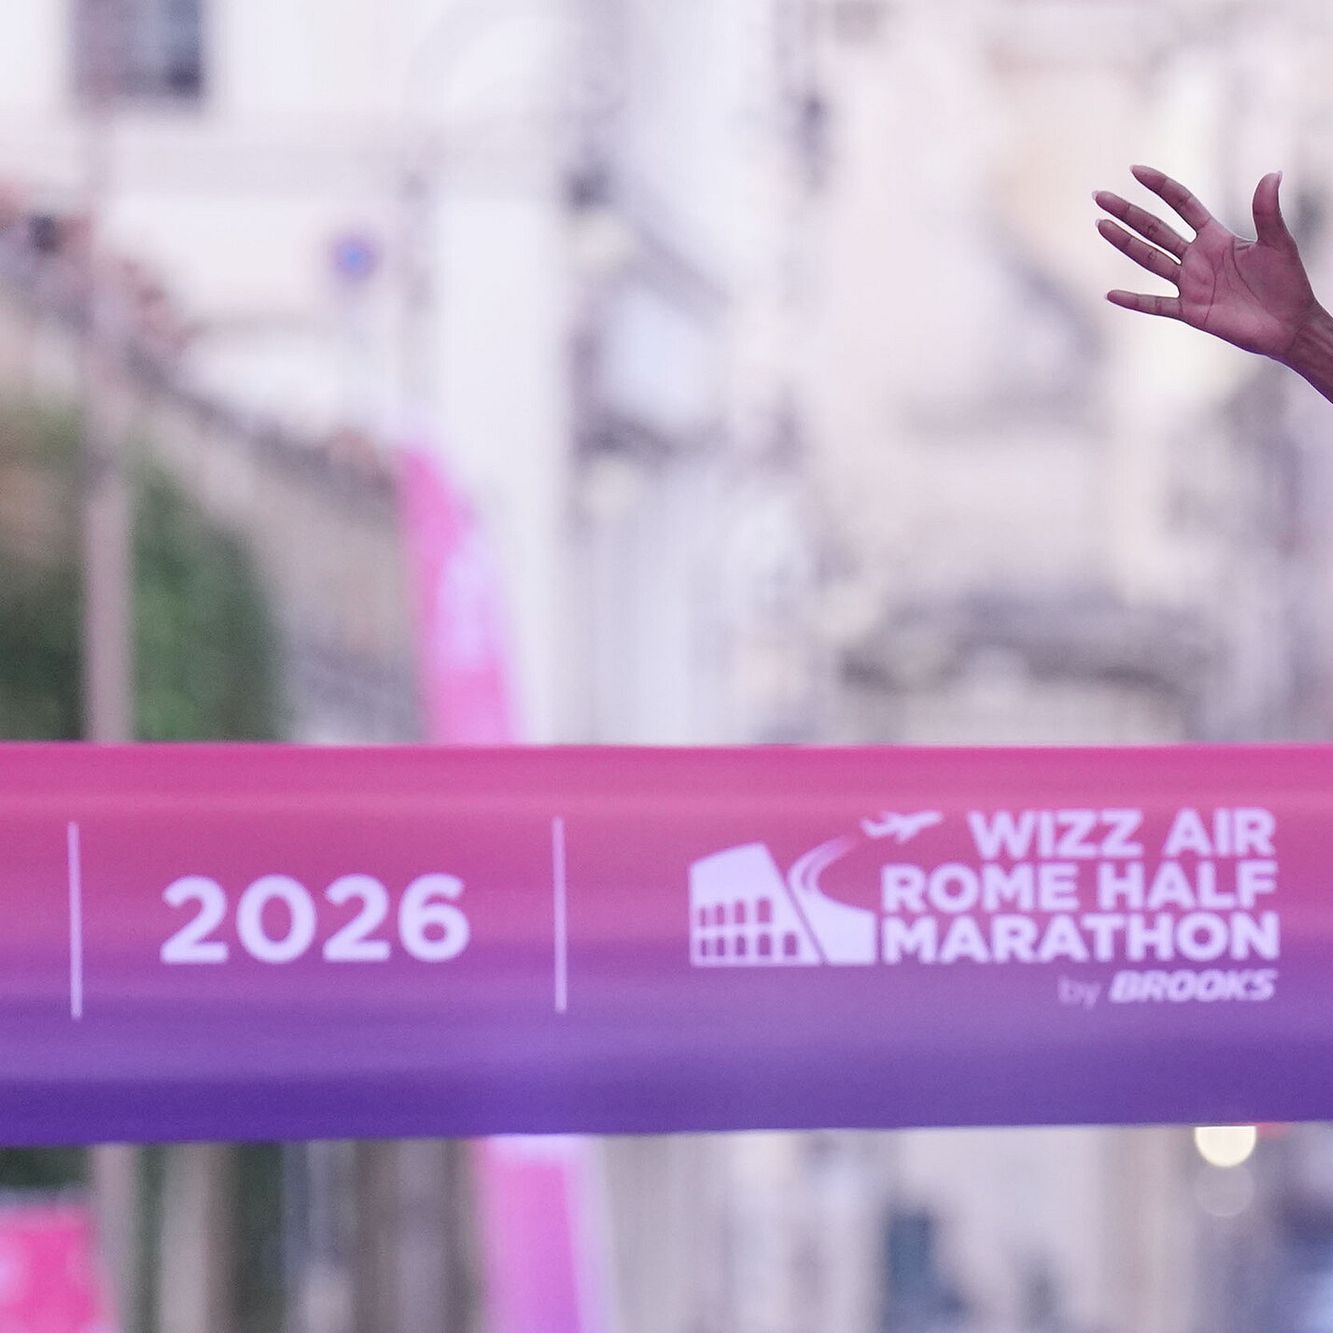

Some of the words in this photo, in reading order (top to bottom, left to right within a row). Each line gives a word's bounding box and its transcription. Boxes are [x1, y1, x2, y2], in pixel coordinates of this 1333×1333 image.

[966, 809, 1144, 859] WIZZ
[1163, 806, 1276, 857] AIR
[880, 863, 1081, 913] ROME
[1095, 858, 1279, 911] HALF
[160, 872, 472, 965] 2026
[880, 912, 1281, 964] MARATHON
[1056, 973, 1103, 1009] by
[1108, 968, 1278, 1004] BROOKS
